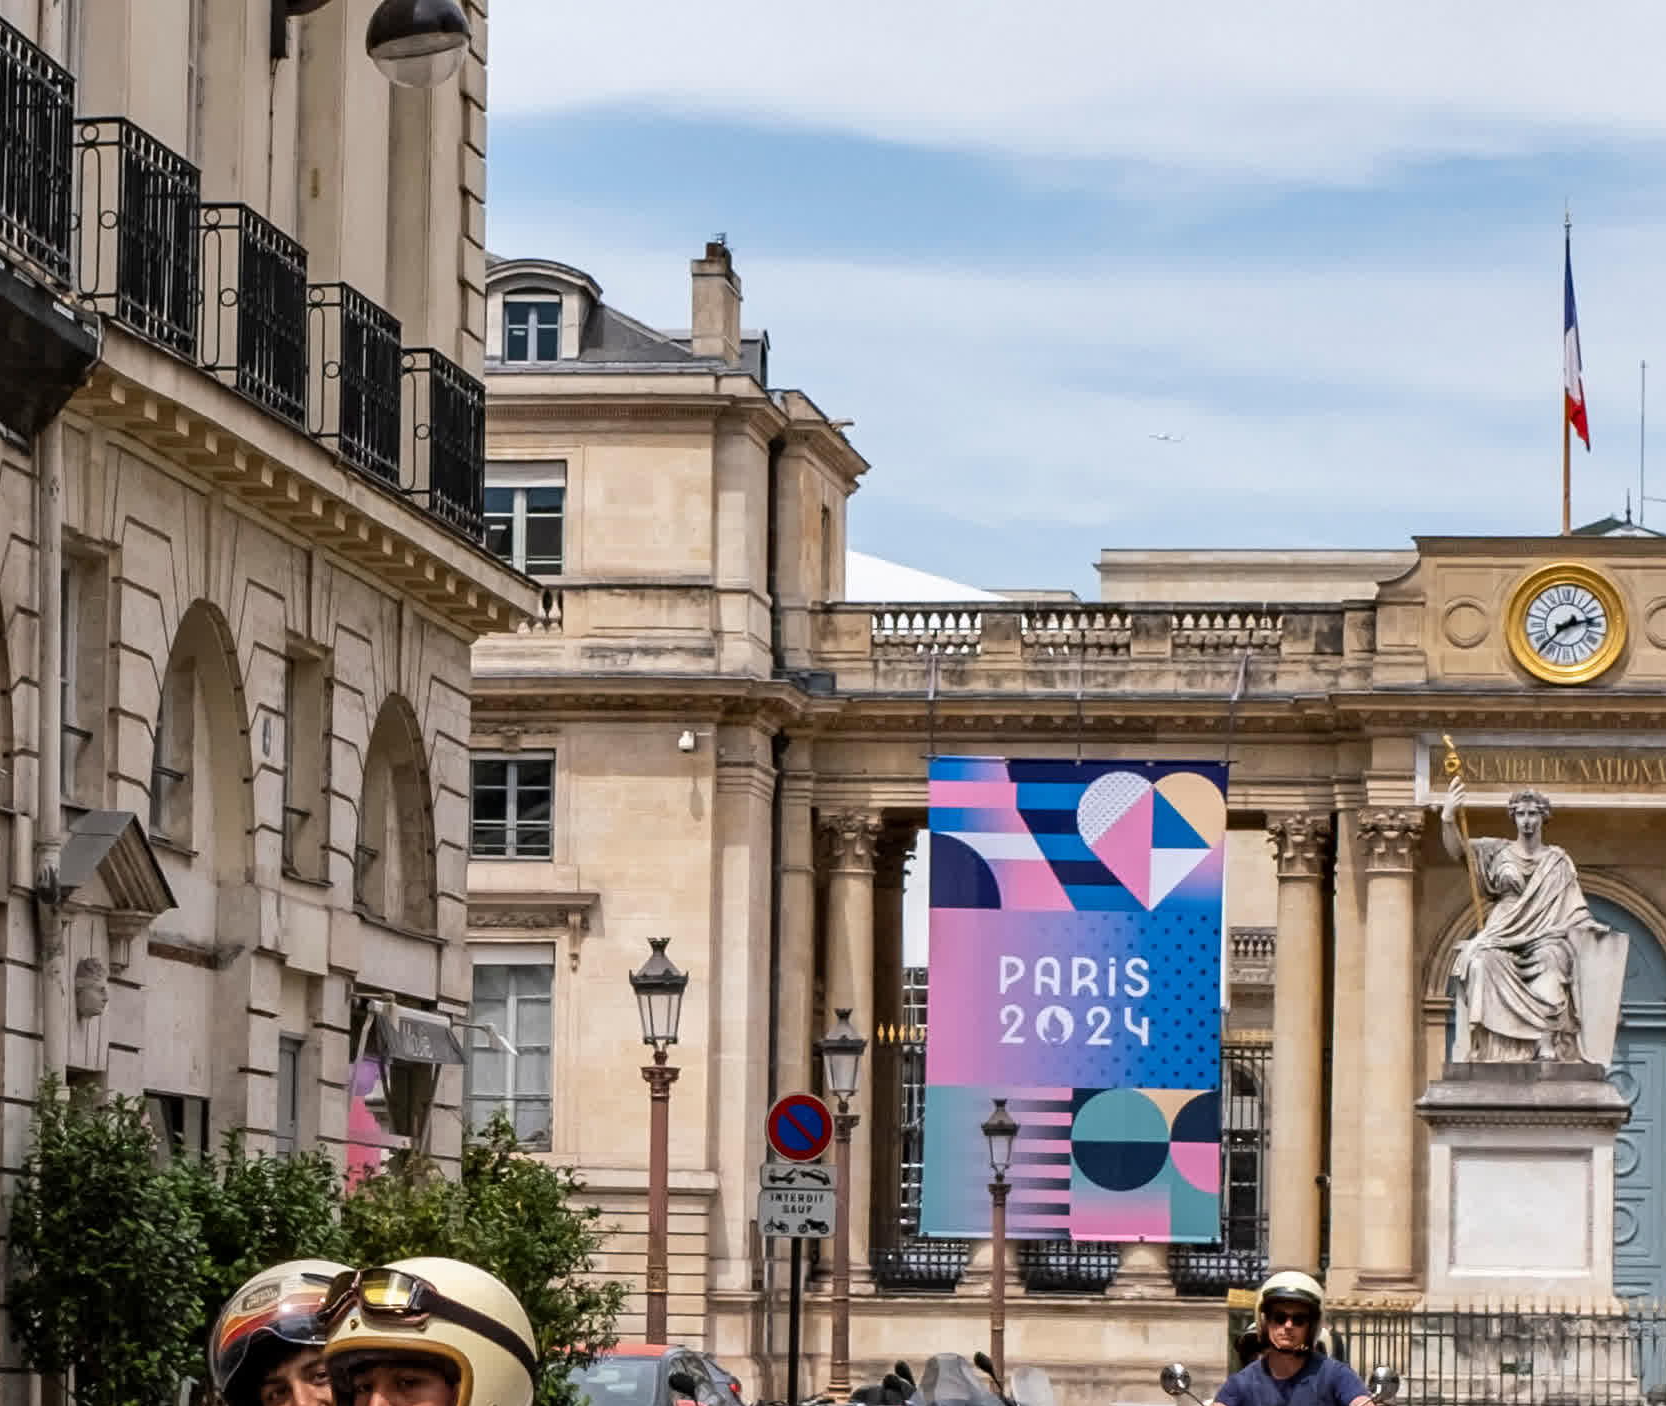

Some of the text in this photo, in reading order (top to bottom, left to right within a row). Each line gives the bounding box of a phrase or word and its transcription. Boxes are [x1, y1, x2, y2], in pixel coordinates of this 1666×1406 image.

[998, 1004, 1150, 1047] 2024
[770, 1193, 824, 1203] INTERDIT
[783, 1205, 813, 1214] SAUF
